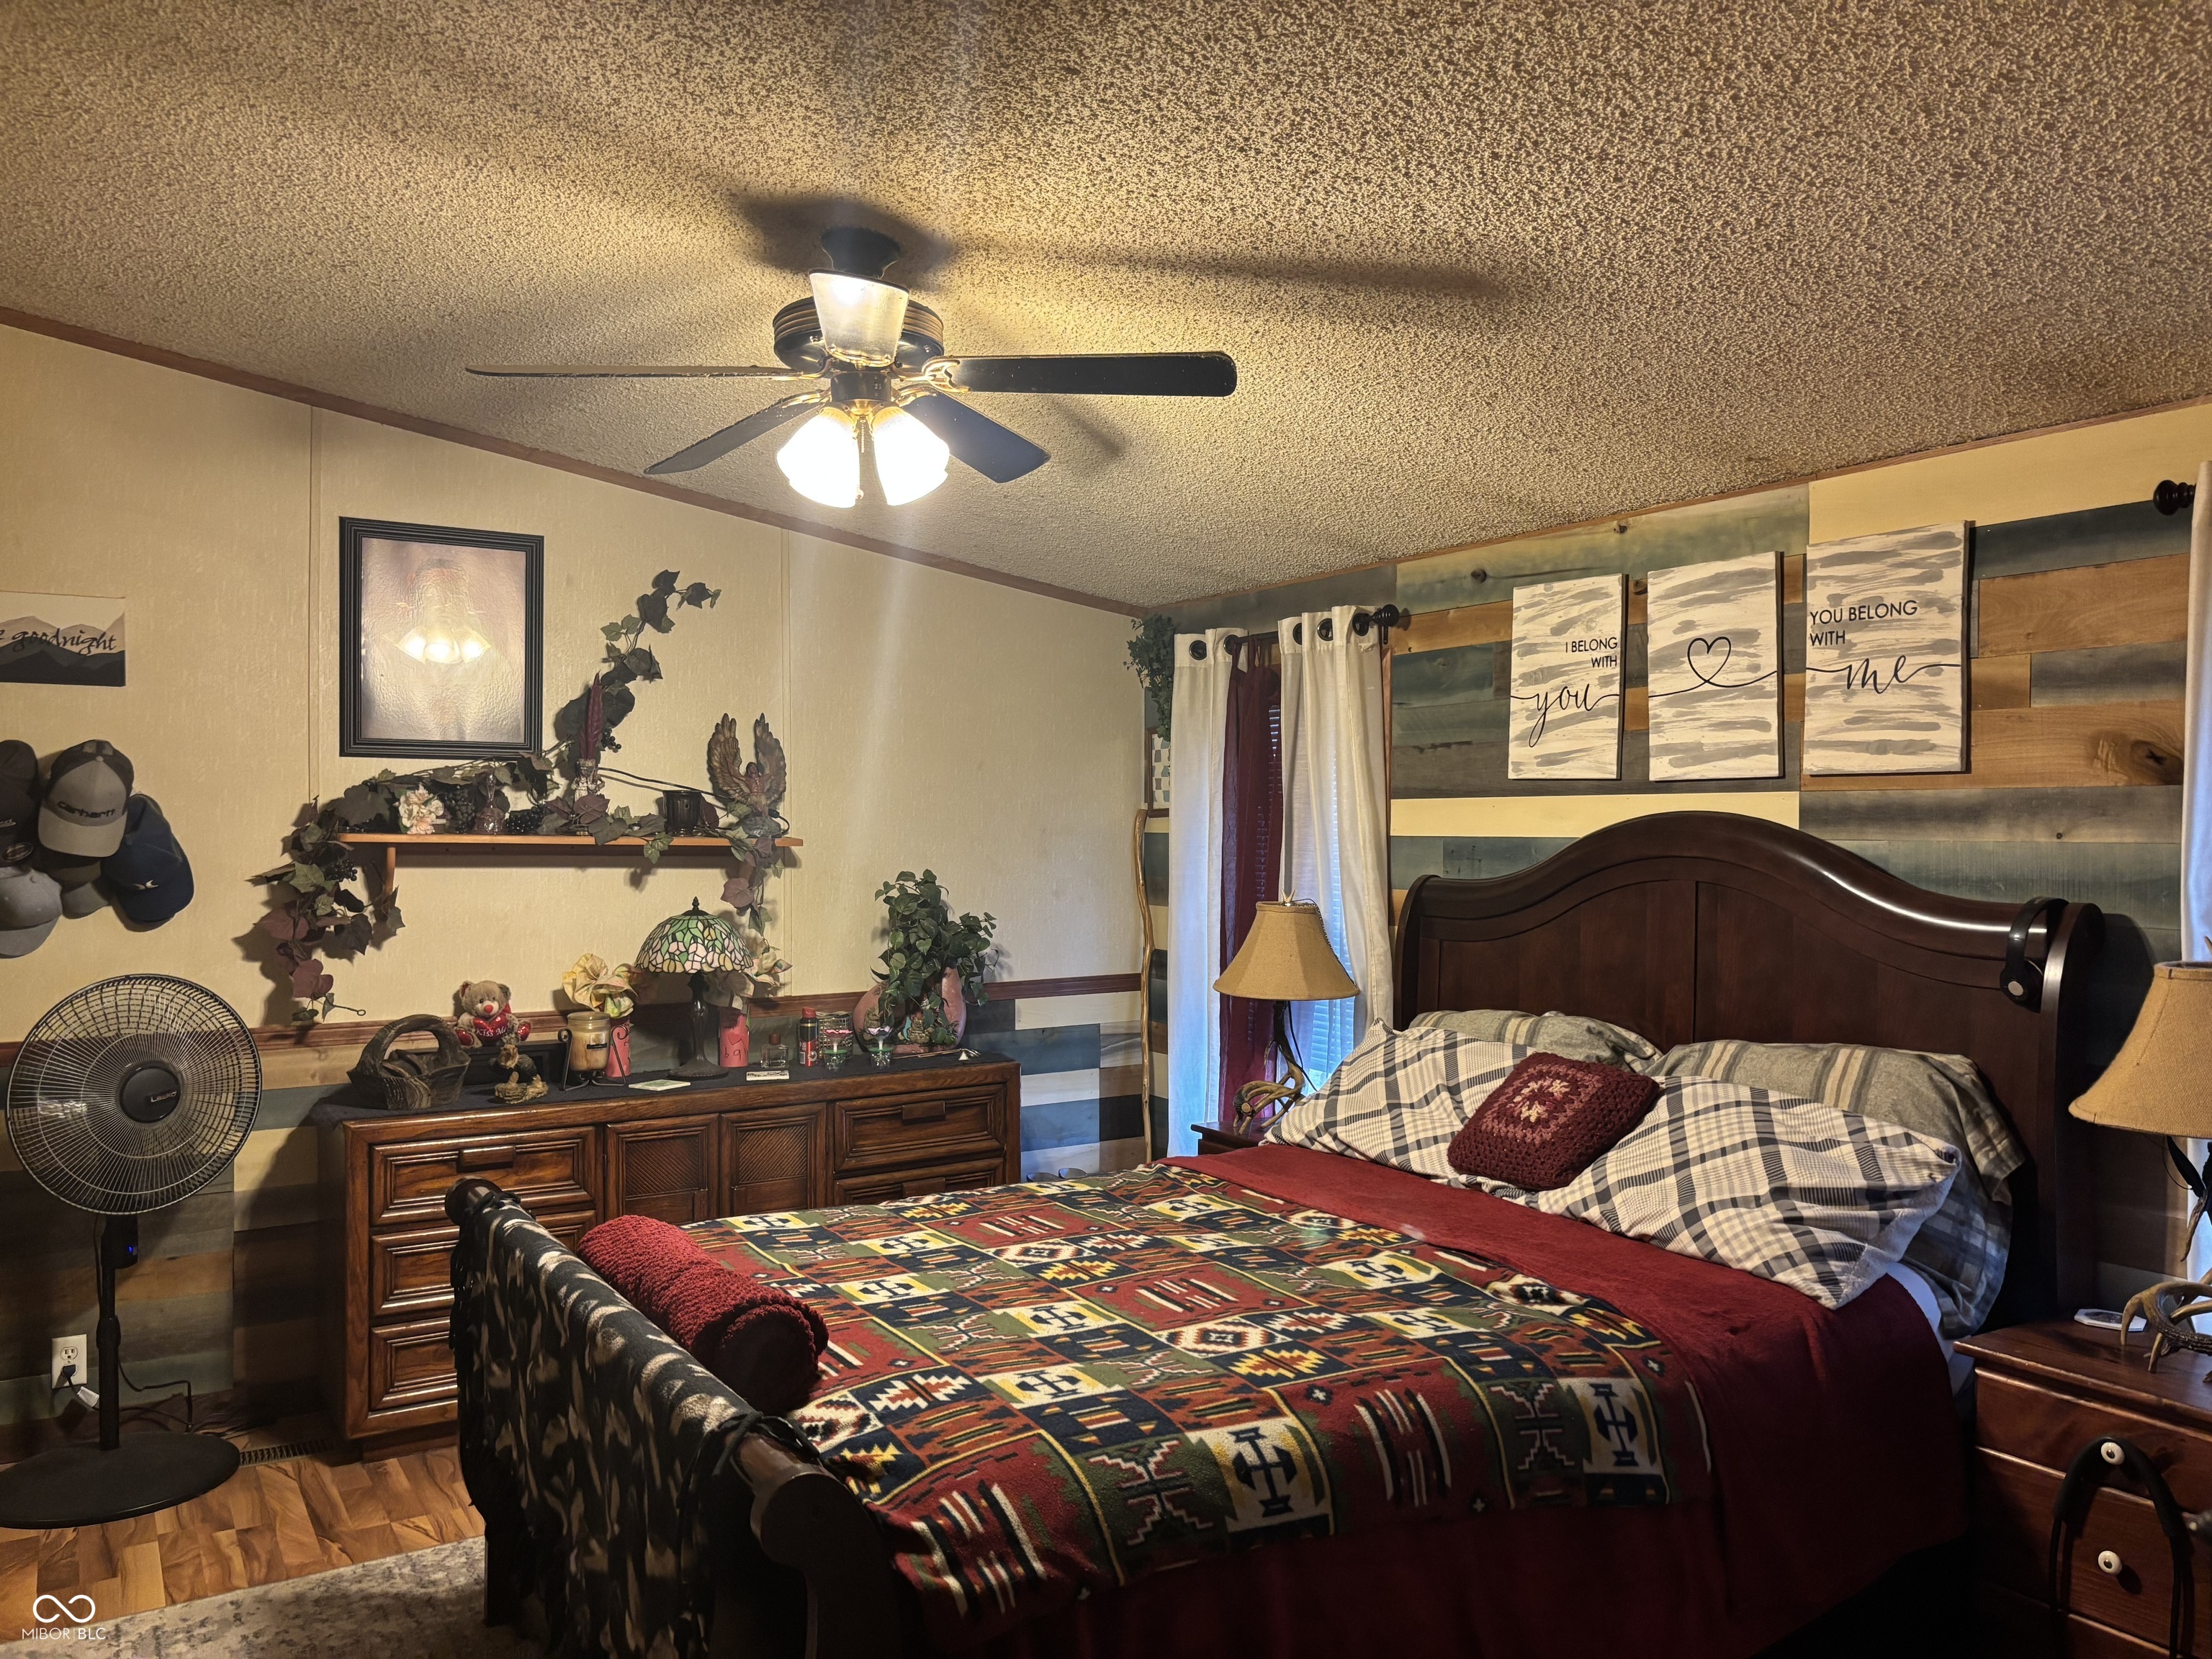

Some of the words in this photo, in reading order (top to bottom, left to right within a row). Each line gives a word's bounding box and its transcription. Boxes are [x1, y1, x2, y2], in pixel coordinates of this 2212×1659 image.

[1809, 608, 1843, 626] YOU
[1848, 600, 1918, 621] BELONG
[12, 628, 117, 656] goodnight
[1565, 642, 1568, 653] I
[1571, 637, 1618, 653] BELONG
[1809, 630, 1845, 646] WITH
[1591, 655, 1618, 668] WITH
[1845, 655, 1915, 694] me
[1528, 683, 1596, 747] you
